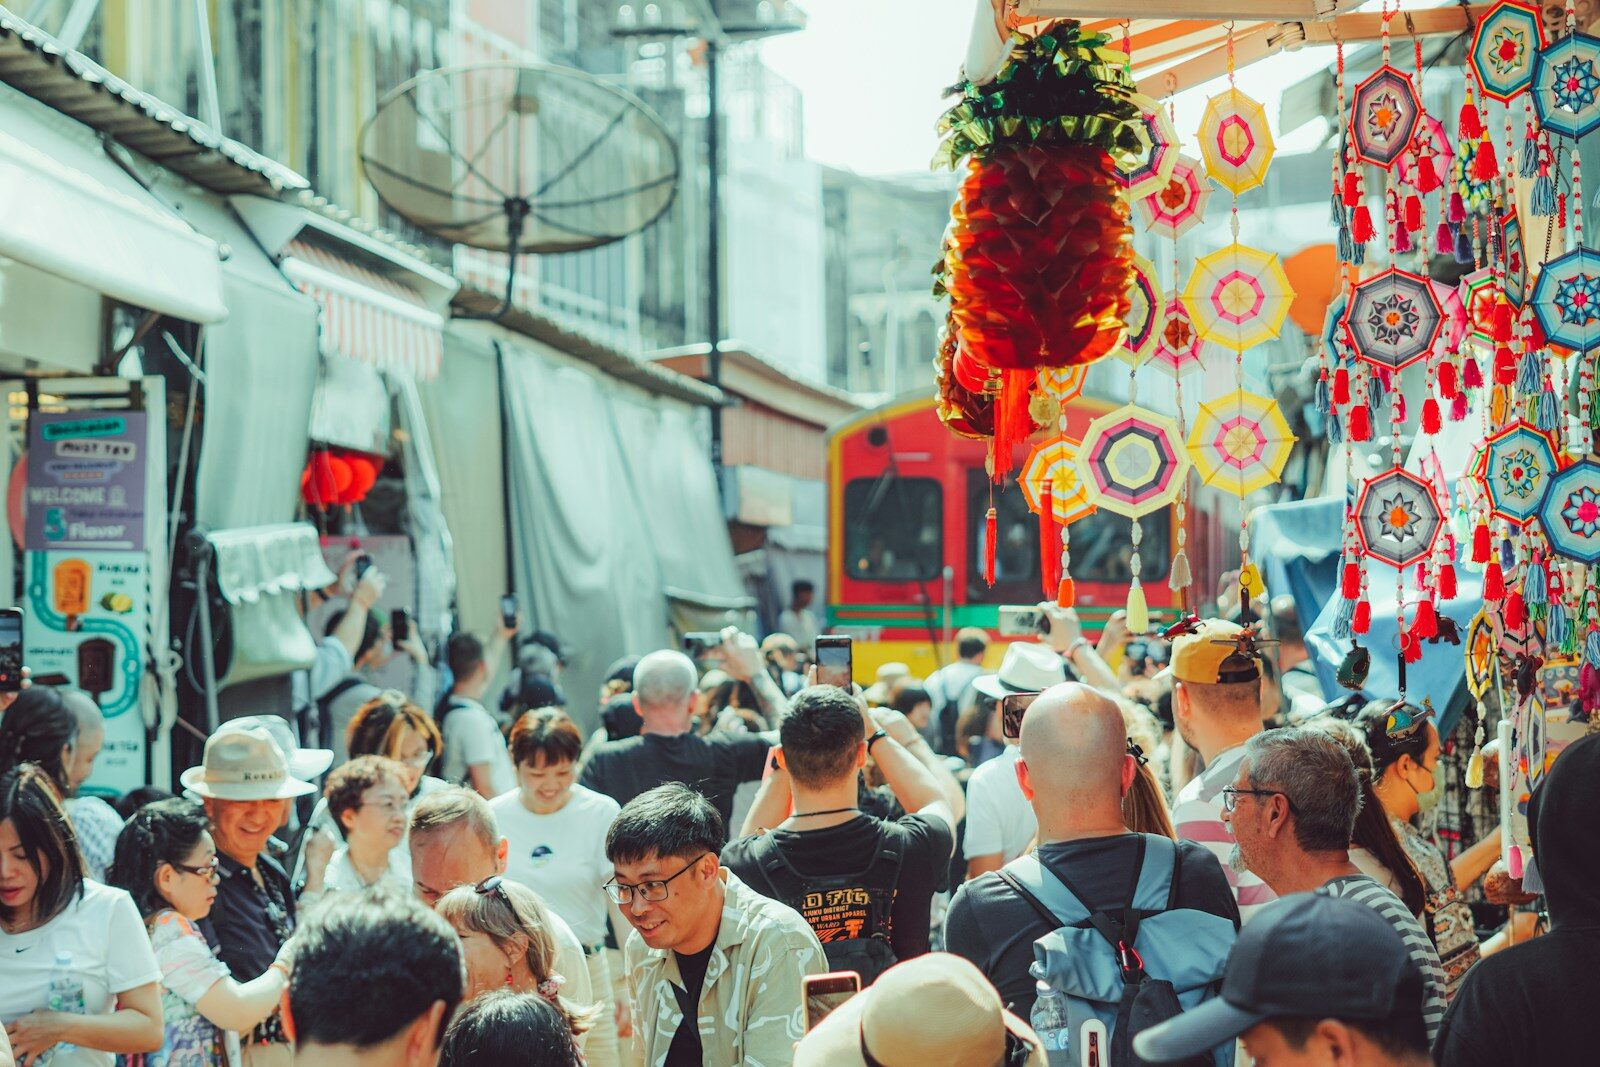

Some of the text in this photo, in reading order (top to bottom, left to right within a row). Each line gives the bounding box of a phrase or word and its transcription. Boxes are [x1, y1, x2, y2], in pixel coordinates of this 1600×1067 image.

[31, 487, 104, 505] WELCOME
[44, 507, 67, 541] 5
[69, 521, 126, 540] Flavor
[824, 905, 849, 913] DISTRICT
[842, 910, 867, 918] APPAREL
